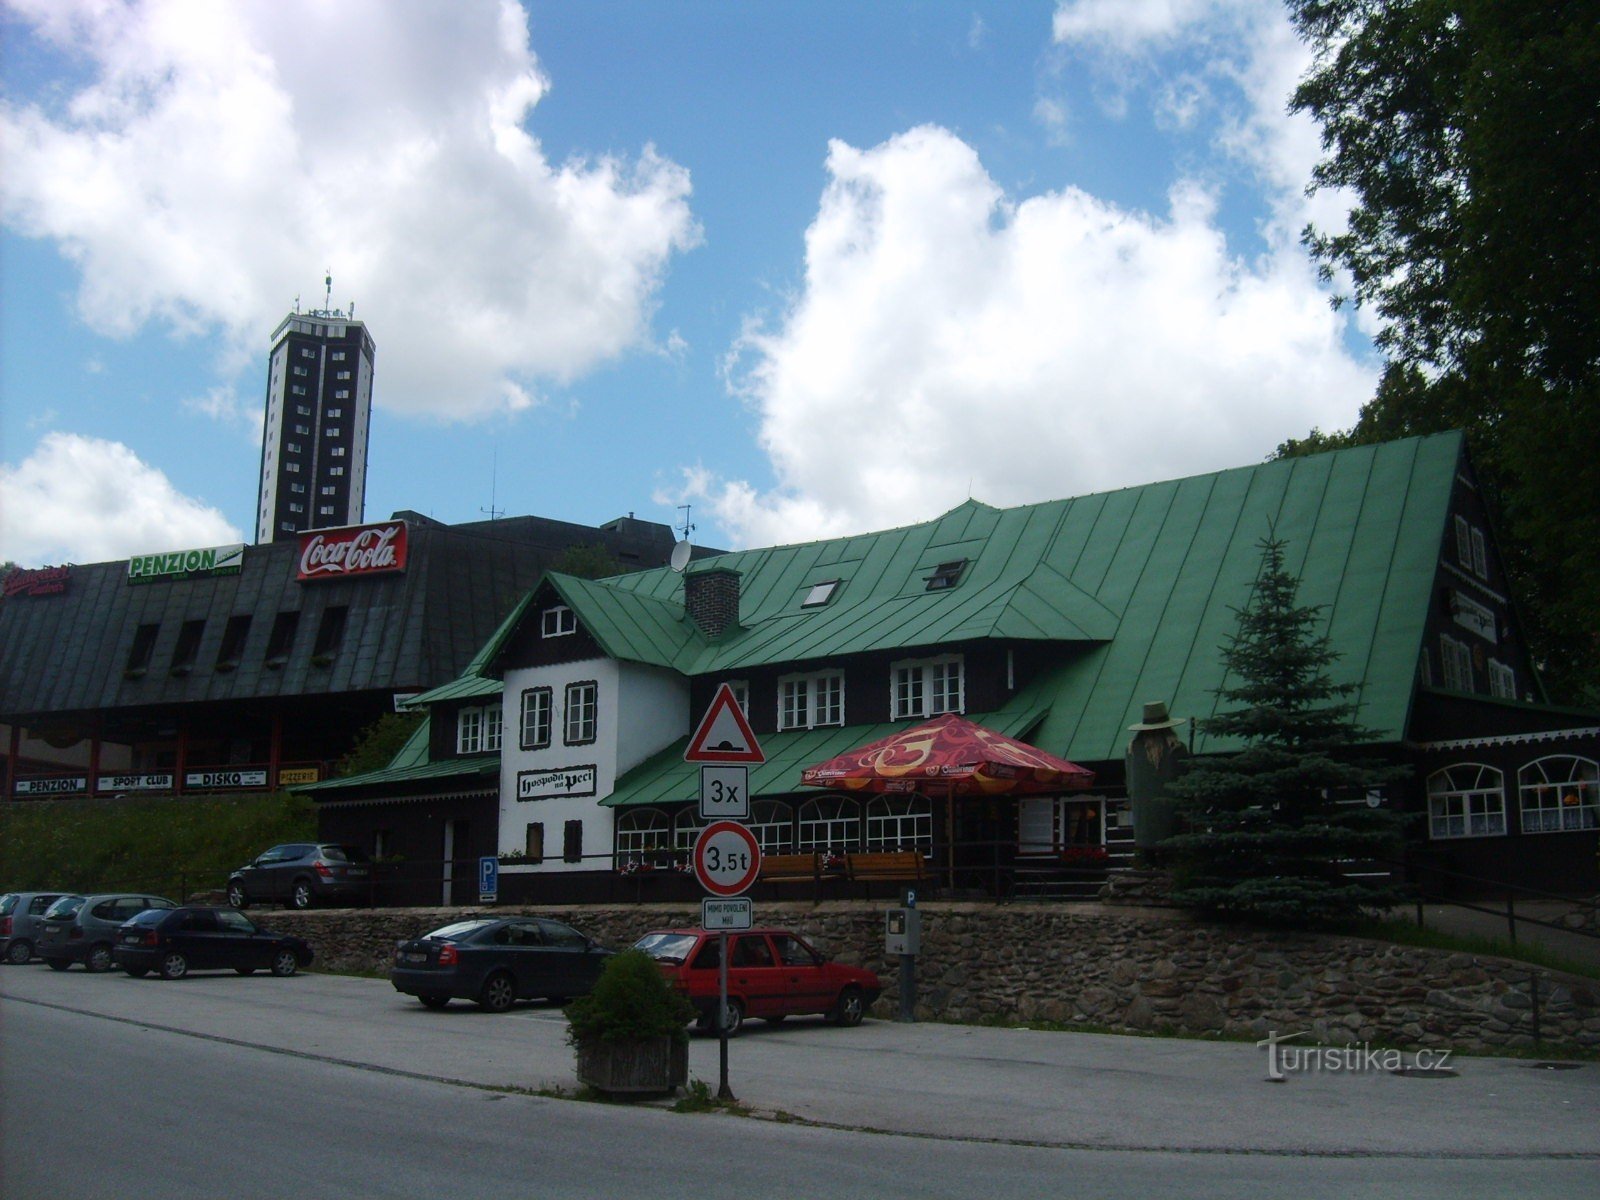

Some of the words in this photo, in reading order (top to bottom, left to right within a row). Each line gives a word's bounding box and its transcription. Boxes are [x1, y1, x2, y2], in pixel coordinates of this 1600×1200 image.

[301, 527, 400, 575] Coca-Cola
[129, 550, 217, 578] PENZION
[113, 777, 141, 786] SPORT
[146, 776, 168, 785] CLUB
[203, 773, 241, 785] DISKO
[30, 780, 78, 792] PENZION
[711, 780, 739, 803] 3x
[483, 861, 493, 882] P
[908, 891, 915, 904] P
[707, 904, 722, 913] MIMO
